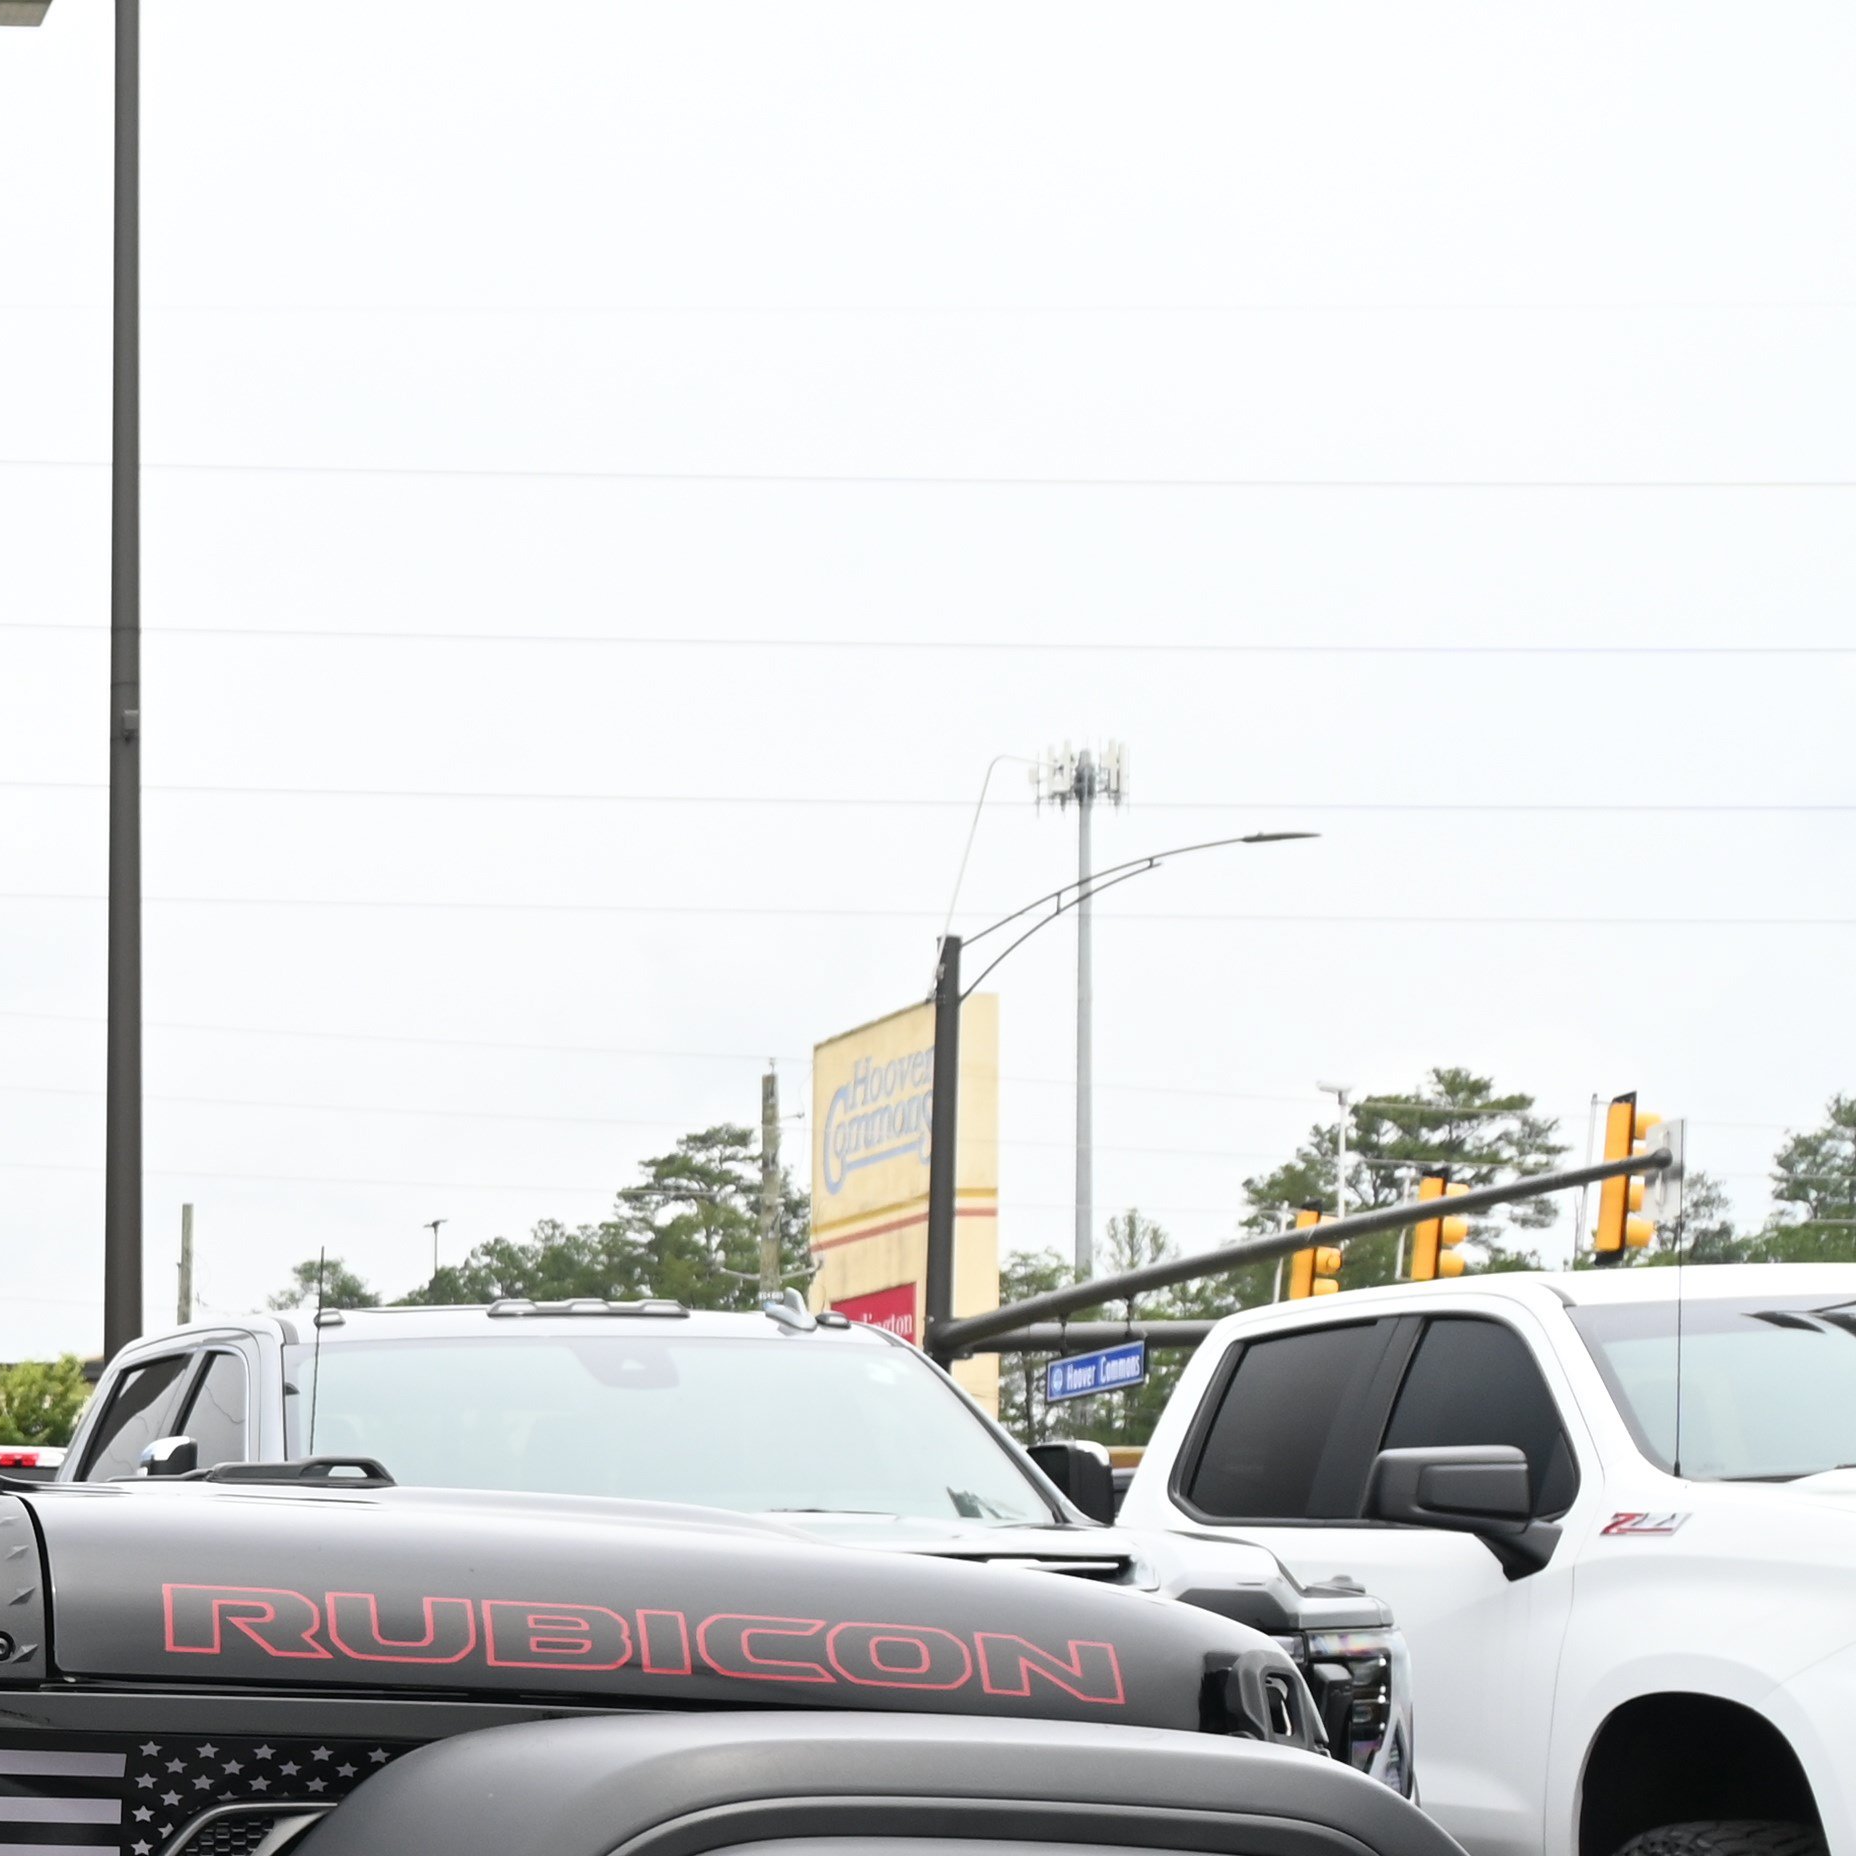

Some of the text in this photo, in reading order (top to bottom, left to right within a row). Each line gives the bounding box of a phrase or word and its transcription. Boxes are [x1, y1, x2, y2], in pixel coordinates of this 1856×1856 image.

[851, 1046, 934, 1111] Hoover
[1067, 1355, 1140, 1391] Hoover Commons
[161, 1583, 1126, 1705] RUBICON
